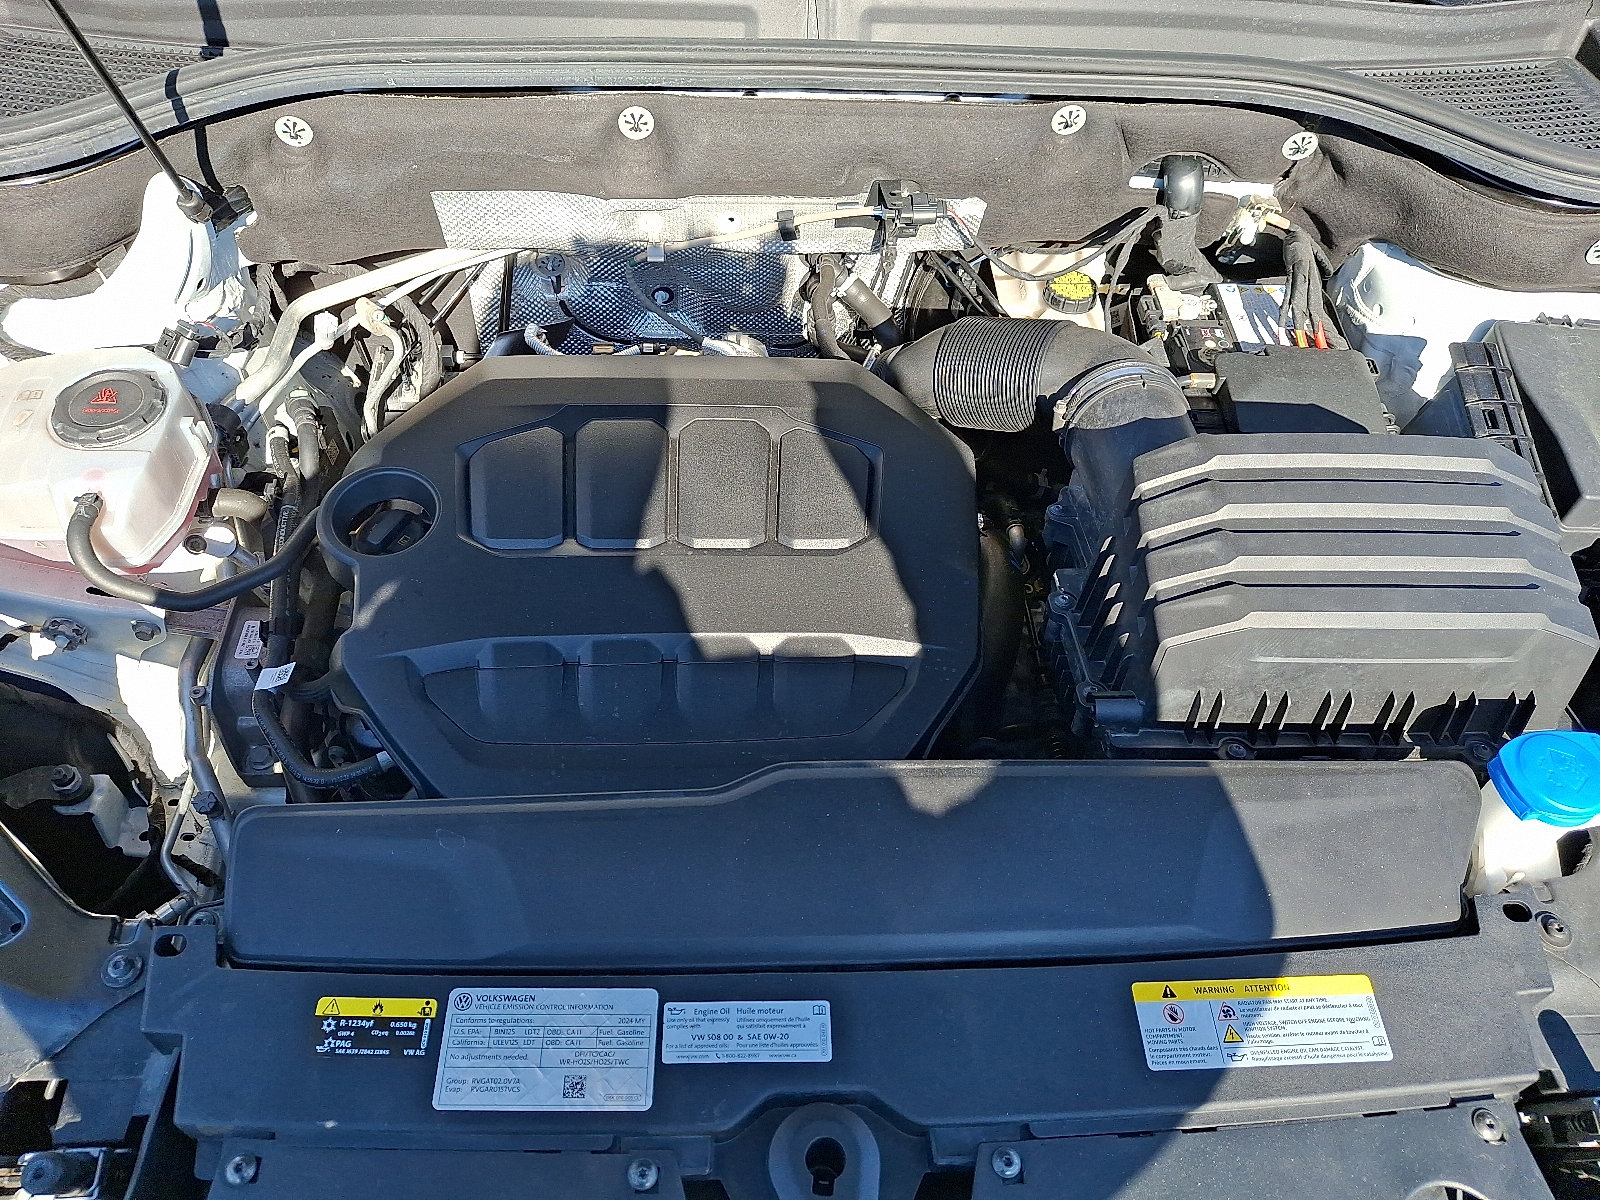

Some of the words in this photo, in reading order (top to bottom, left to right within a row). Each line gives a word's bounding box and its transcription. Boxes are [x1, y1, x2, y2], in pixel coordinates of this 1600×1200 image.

[1194, 986, 1234, 994] WARNING
[1244, 984, 1290, 992] ATTENTION
[694, 1008, 718, 1017] Engine
[340, 1019, 375, 1028] R-1234yf
